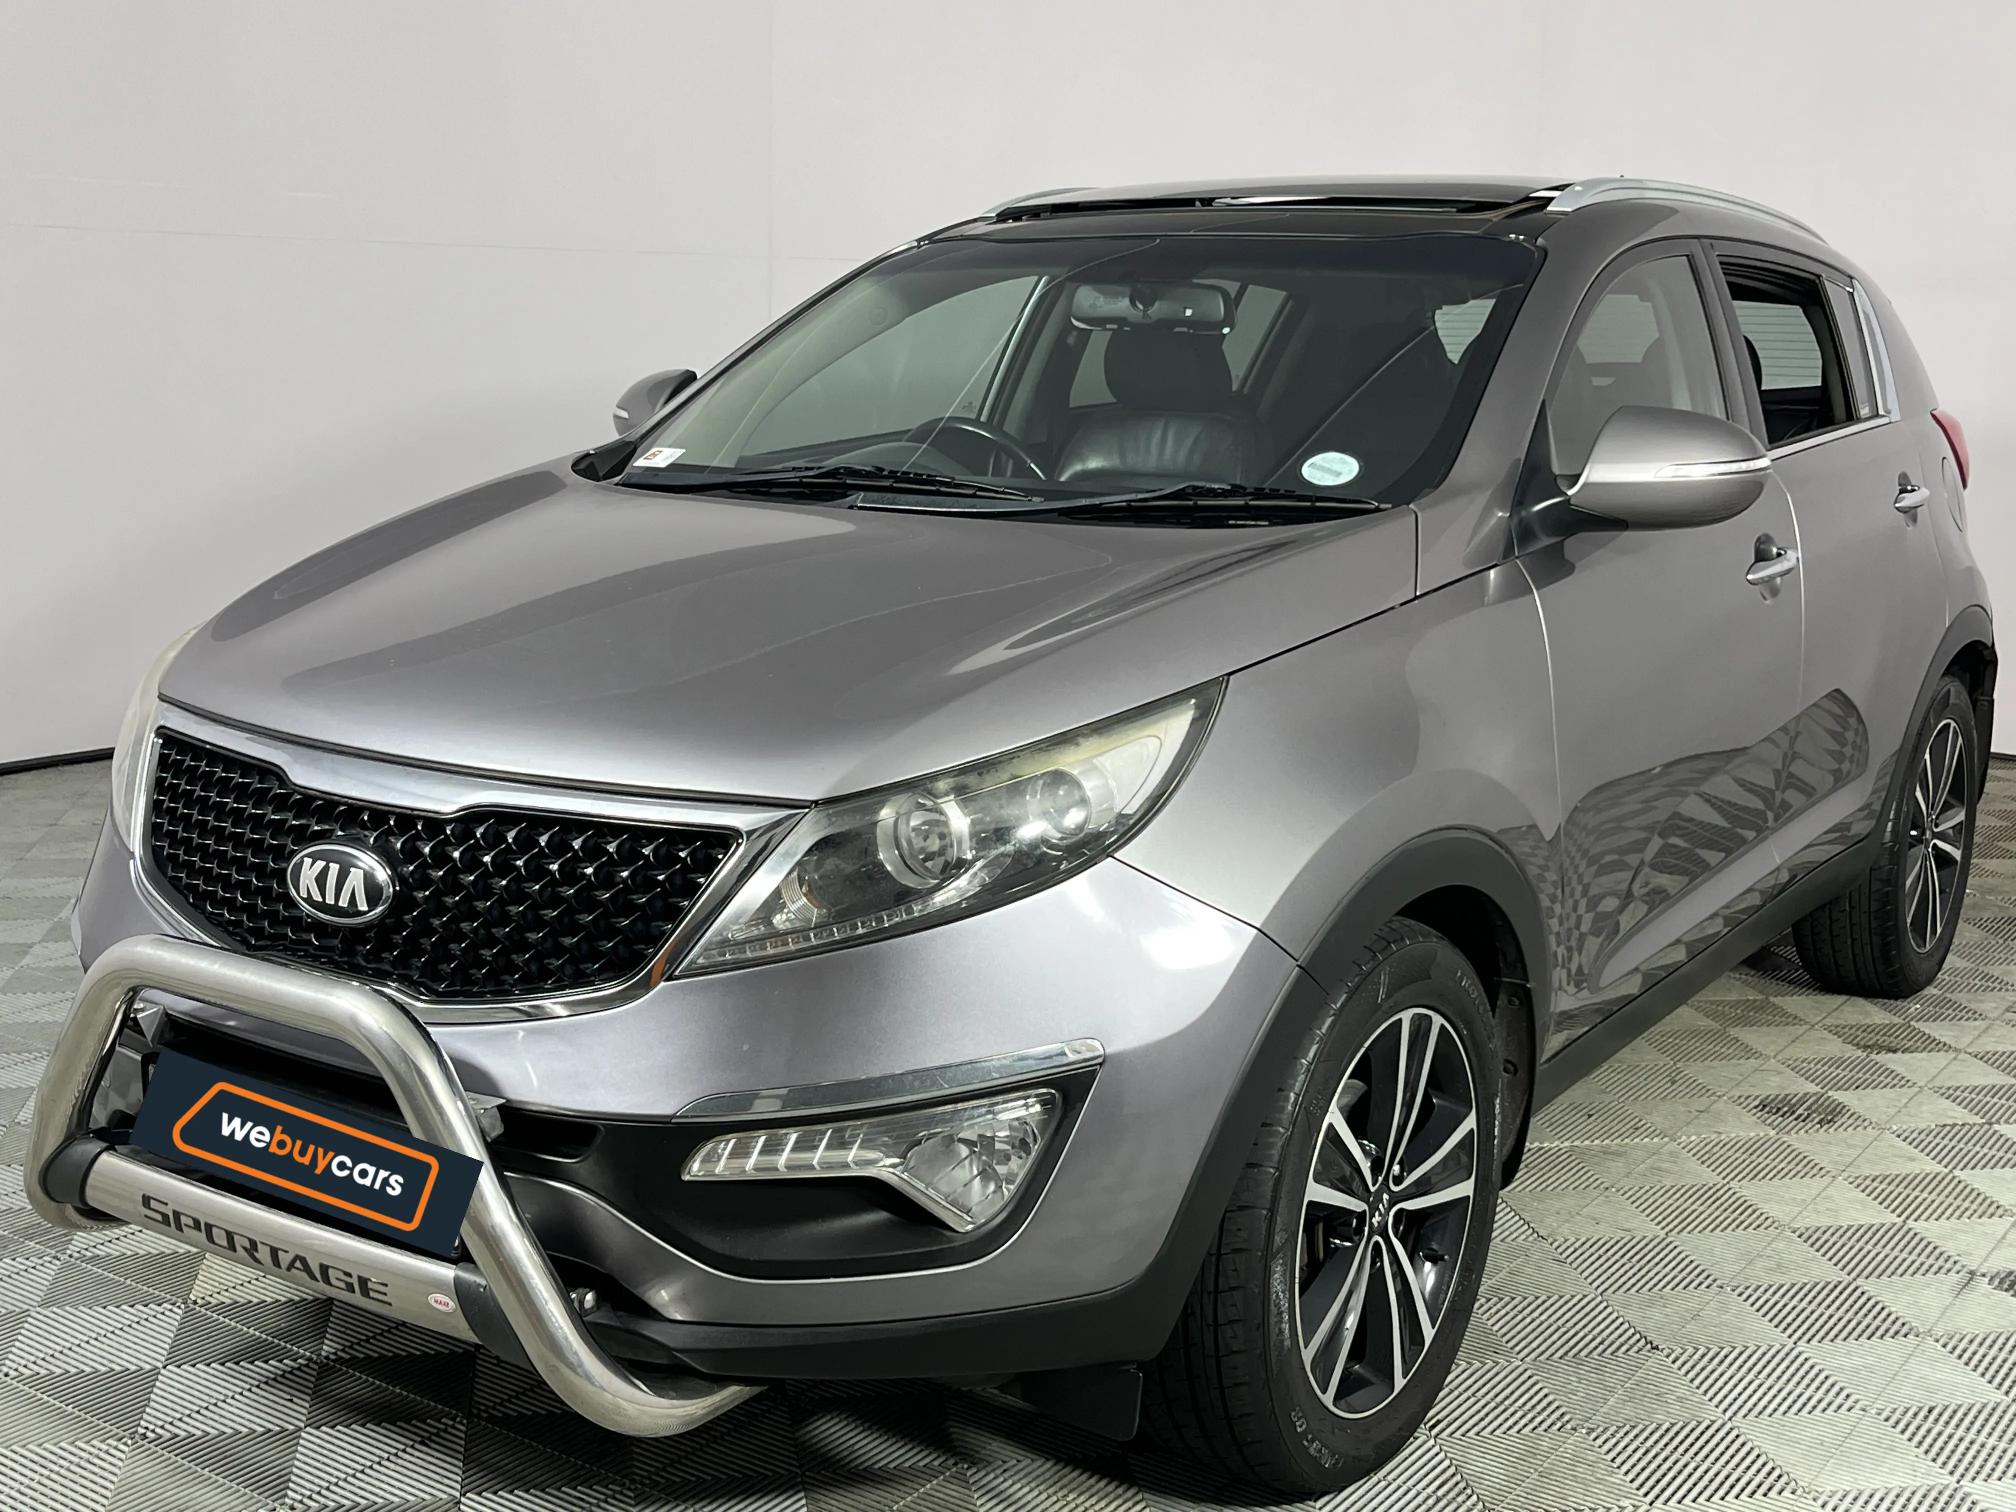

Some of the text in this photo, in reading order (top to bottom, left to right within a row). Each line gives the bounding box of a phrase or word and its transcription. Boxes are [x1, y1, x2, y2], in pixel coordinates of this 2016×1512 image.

[299, 857, 369, 911] KIA
[1371, 1193, 1390, 1228] KIA
[141, 1193, 393, 1307] SPORTAGE
